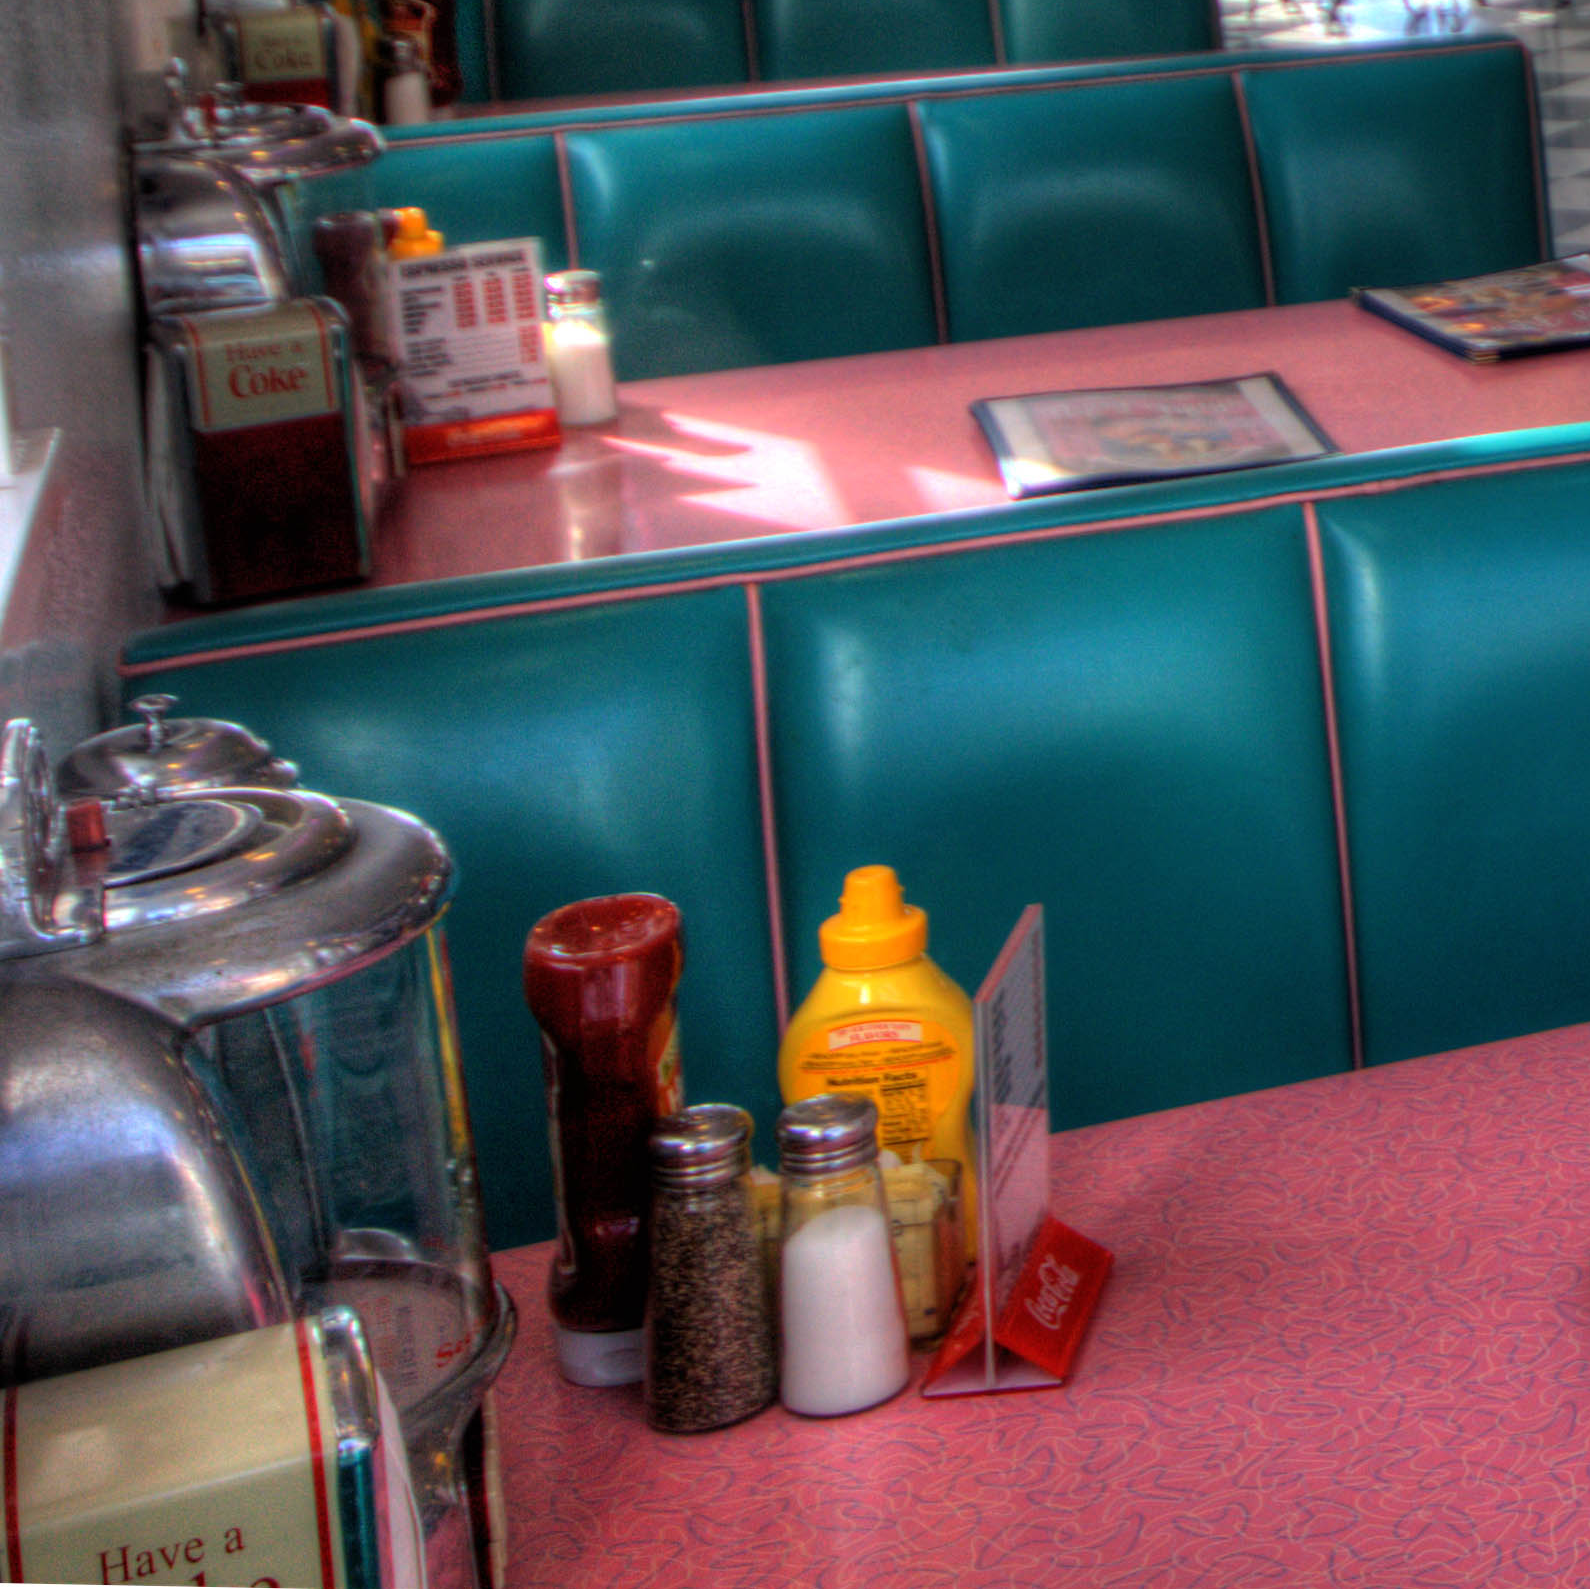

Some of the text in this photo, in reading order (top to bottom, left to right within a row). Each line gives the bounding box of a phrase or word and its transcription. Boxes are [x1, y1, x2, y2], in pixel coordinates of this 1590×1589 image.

[228, 363, 307, 400] Coke
[1024, 1254, 1081, 1332] Coca-Cola
[97, 1537, 206, 1586] Have
[223, 1526, 246, 1554] a
